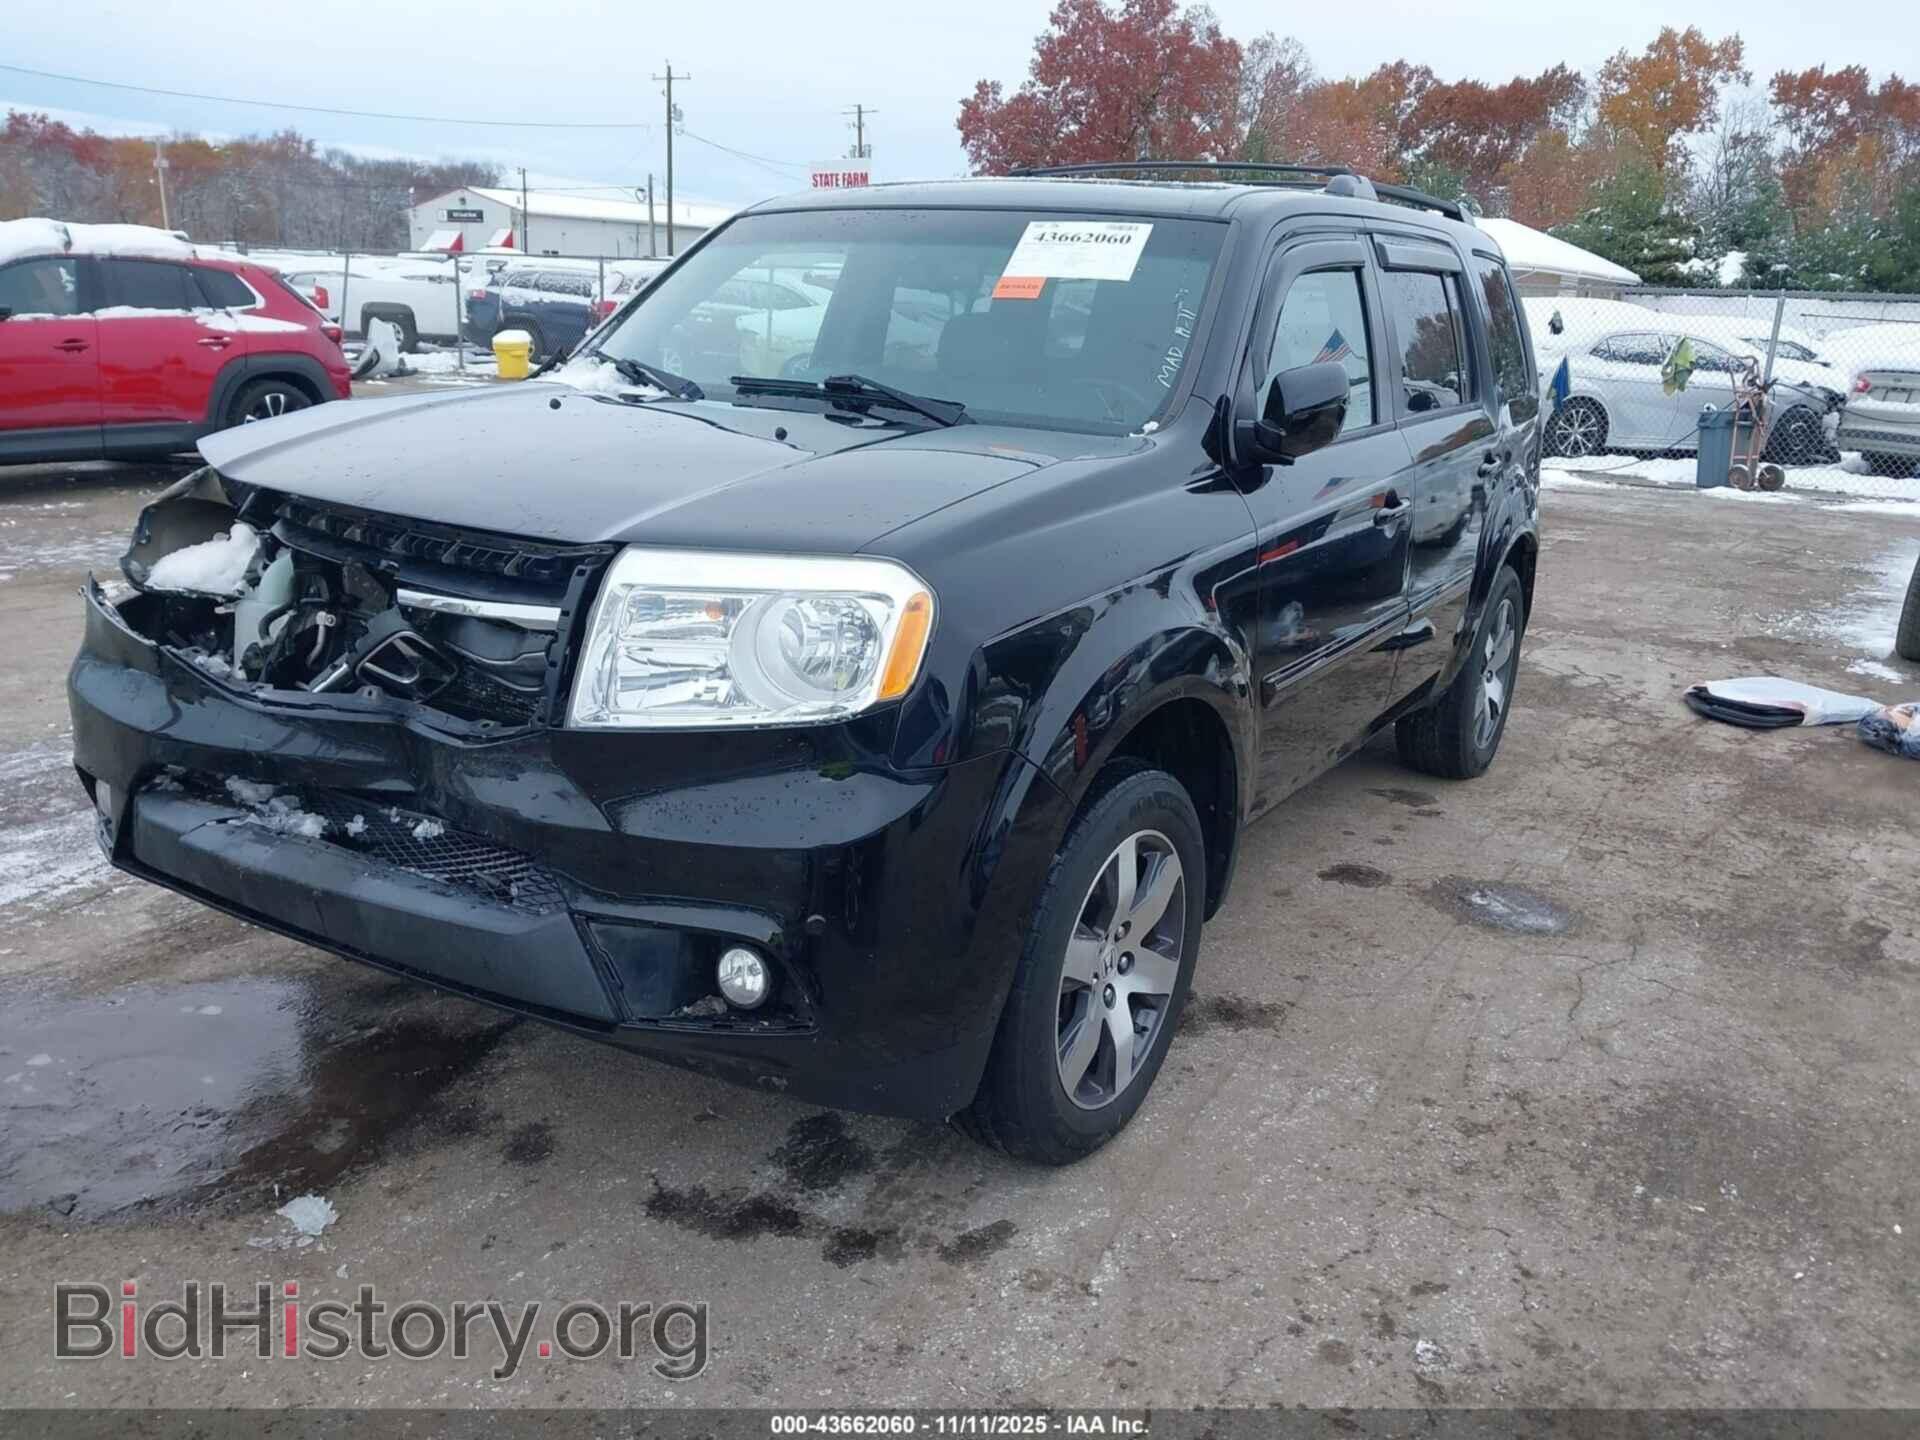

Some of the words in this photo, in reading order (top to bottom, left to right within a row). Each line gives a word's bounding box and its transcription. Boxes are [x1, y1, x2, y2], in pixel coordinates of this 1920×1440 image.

[812, 172, 840, 187] STATE
[842, 171, 869, 188] FARM
[1033, 231, 1132, 245] 43662060
[1157, 346, 1183, 388] MAD
